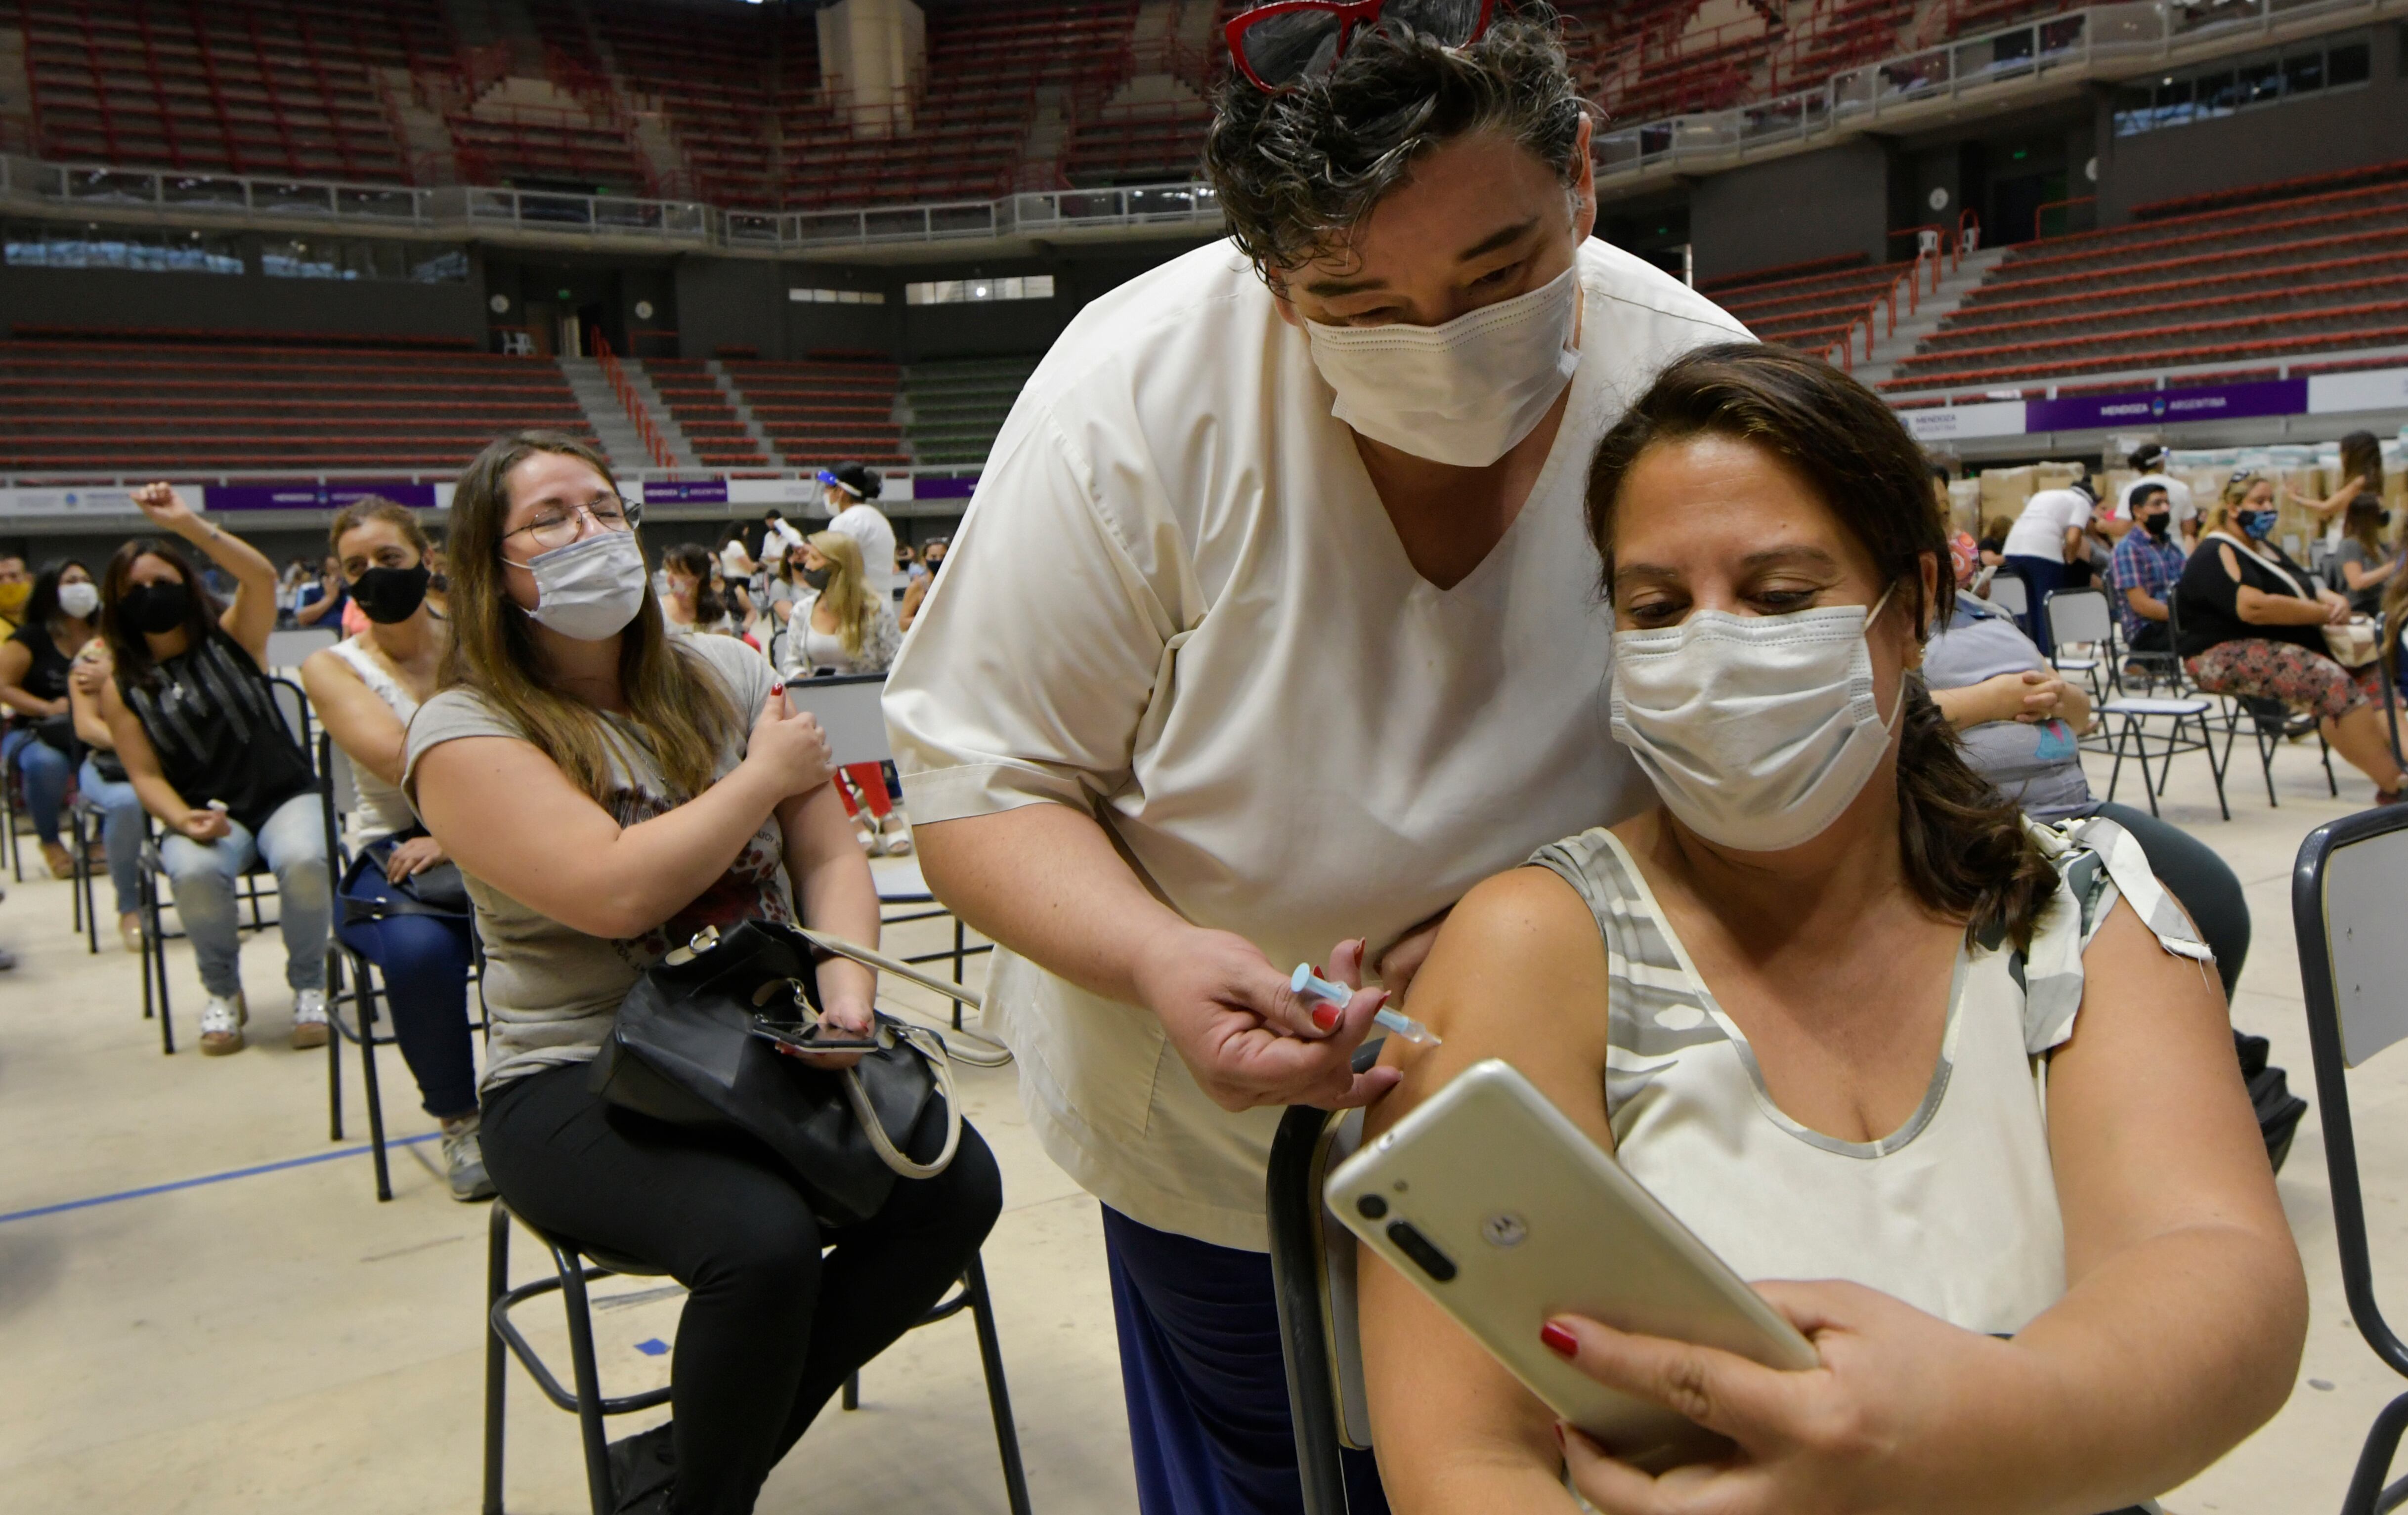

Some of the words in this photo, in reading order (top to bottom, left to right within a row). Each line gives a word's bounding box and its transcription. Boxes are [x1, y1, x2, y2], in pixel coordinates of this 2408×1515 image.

[2100, 403, 2149, 416] MENDOZA
[2170, 397, 2227, 410] ARGENTINA
[1916, 414, 1955, 423] MENDOZA
